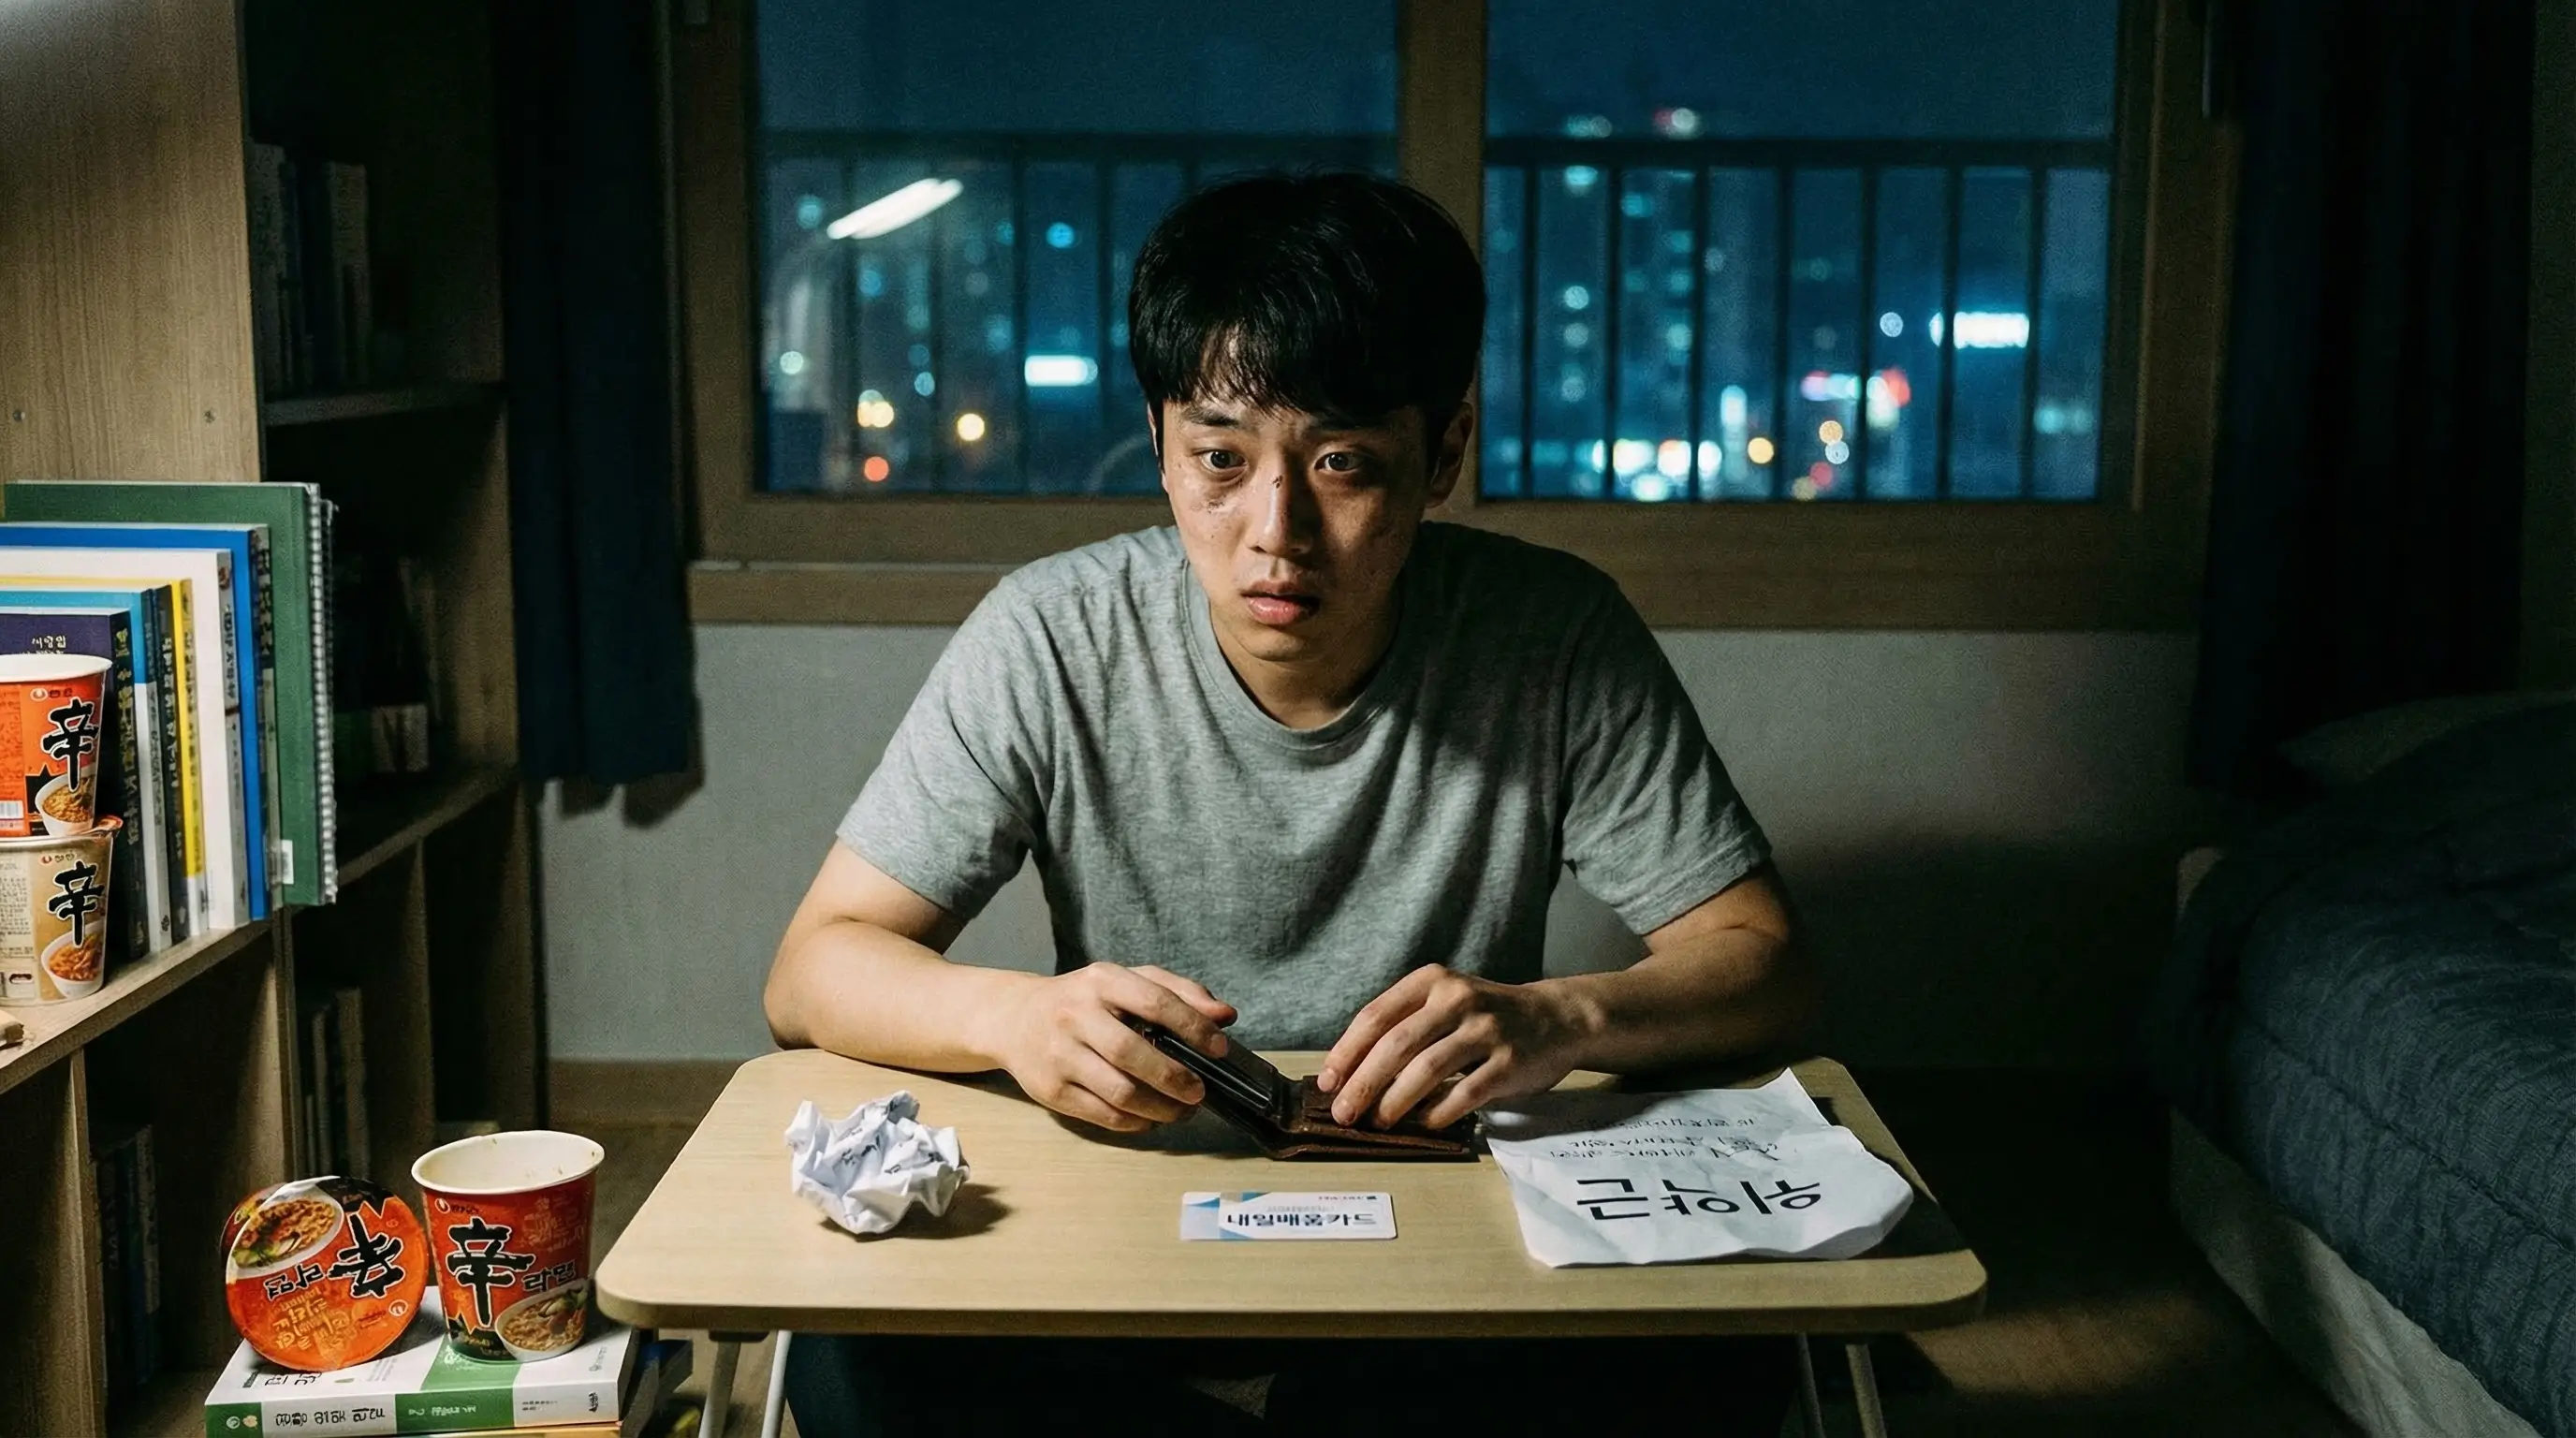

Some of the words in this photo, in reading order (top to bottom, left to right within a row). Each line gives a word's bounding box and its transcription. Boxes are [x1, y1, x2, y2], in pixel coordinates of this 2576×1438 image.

[42, 699, 98, 792] 辛
[50, 862, 104, 946] 辛
[266, 1264, 324, 1300] 라면
[329, 1214, 404, 1298] 辛
[446, 1218, 535, 1328] 辛
